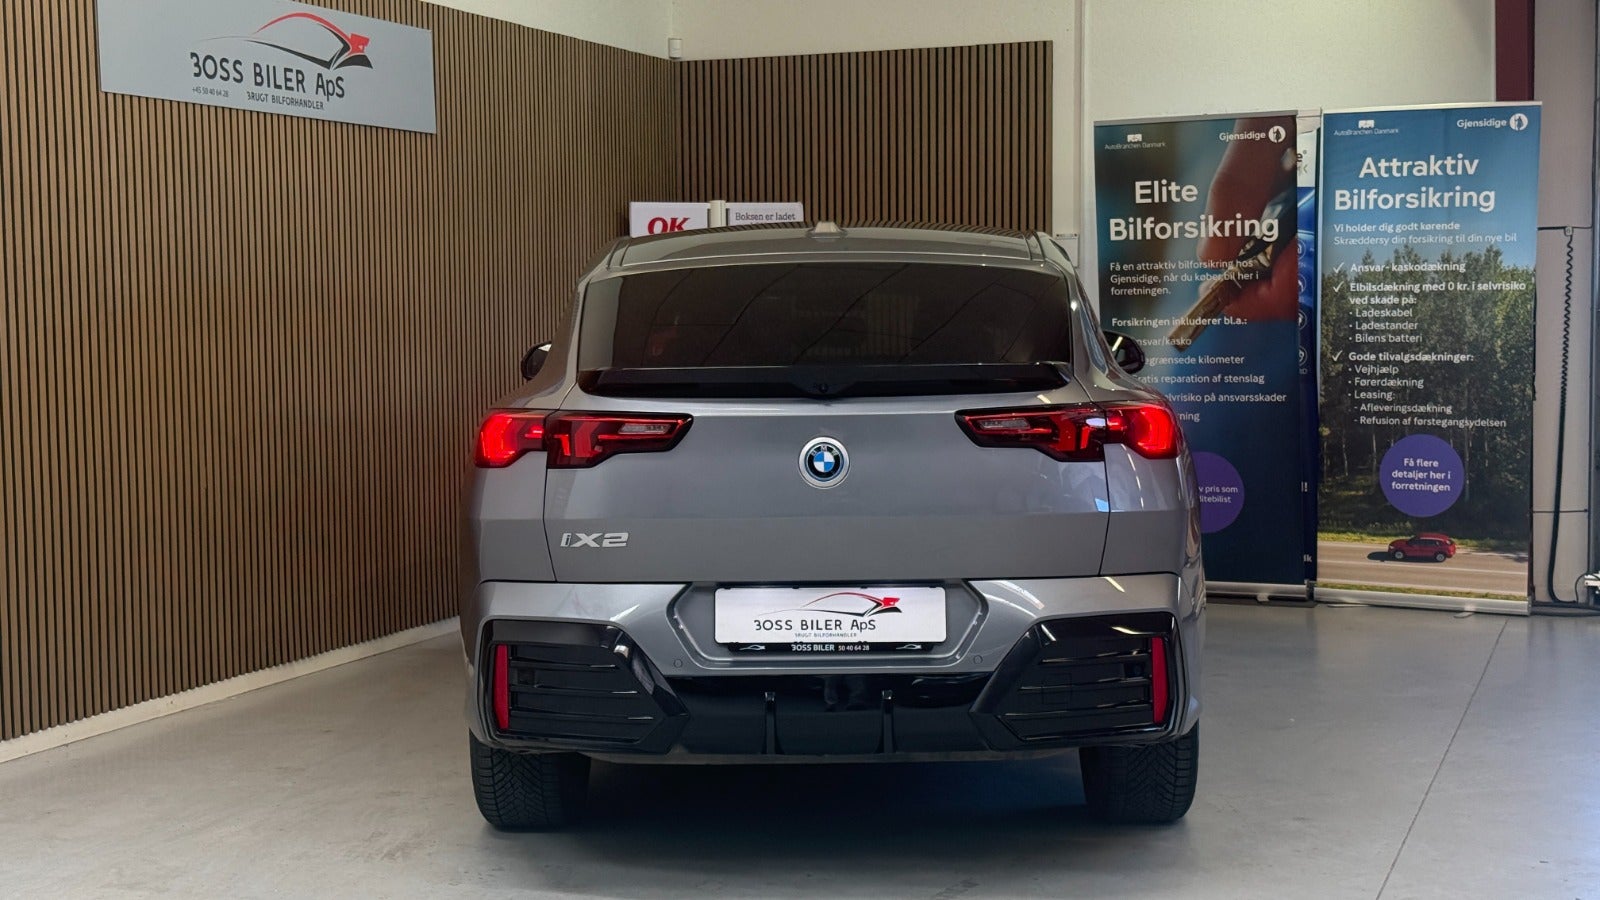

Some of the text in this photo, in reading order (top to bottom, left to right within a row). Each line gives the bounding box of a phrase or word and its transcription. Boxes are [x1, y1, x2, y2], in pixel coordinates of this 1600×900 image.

[253, 62, 306, 93] BILER
[315, 73, 345, 101] ApS
[271, 95, 325, 110] BILFORHANDLER
[1456, 119, 1507, 129] Gjensidige
[1219, 130, 1266, 142] Gjensidige
[1358, 153, 1480, 178] Attraktiv
[1135, 178, 1199, 204] Elite
[1335, 185, 1496, 212] Bilforsikring
[735, 212, 763, 221] Boksen
[775, 212, 796, 221] ladet
[647, 217, 690, 235] OK
[1109, 212, 1279, 243] Bilforsikring
[1334, 221, 1460, 234] Vi holder dig godt kørende
[1334, 233, 1517, 247] Skræddersy din forsikring til din nye bil
[1110, 259, 1253, 271] Få en attraktiv bilforsikring hos
[1350, 262, 1466, 273] Ansvar- kaskodækning
[1110, 273, 1162, 285] Gjensidige,
[1163, 272, 1178, 282] når
[1180, 272, 1193, 281] du
[1194, 272, 1222, 281] køber
[1223, 272, 1236, 281] bil
[1237, 271, 1253, 280] her
[1110, 286, 1171, 297] forretningen.
[1350, 282, 1420, 293] Elbilsdækning
[1422, 282, 1445, 291] med
[1447, 282, 1455, 291] 0
[1457, 281, 1470, 291] kr.
[1477, 281, 1526, 291] selvrisiko
[1350, 295, 1417, 306] ved skade på:
[1355, 308, 1413, 318] Ladeskabel
[1112, 317, 1248, 328] Forsikringen inkluderer bl.a.:
[1355, 321, 1418, 330] Ladestander
[1136, 336, 1192, 346] nsvar/kasko
[1355, 334, 1423, 343] Bilens batteri
[1198, 355, 1245, 365] kilometer
[1348, 352, 1474, 363] Gode tilvalgsdækninger:
[1354, 364, 1399, 375] Vejhjælp
[1161, 374, 1209, 385] reparation
[1211, 374, 1222, 383] af
[1223, 374, 1265, 385] stenslag
[1354, 377, 1424, 389] Førerdækning
[1204, 393, 1216, 403] på
[1217, 393, 1287, 402] ansvarsskader
[1354, 390, 1396, 401] Leasing:
[1359, 403, 1453, 414] Afleveringsdækning
[1359, 416, 1507, 428] Refusion af førstegangsydelsen
[1403, 457, 1439, 468] Få flere
[1391, 469, 1428, 480] detaljer
[1430, 470, 1446, 480] her
[1205, 485, 1220, 494] pris
[1391, 481, 1451, 493] forretningen
[1199, 494, 1232, 504] litebilist
[560, 532, 629, 548] iX2
[800, 619, 843, 631] BILER
[850, 619, 876, 633] ApS
[813, 643, 835, 652] BILER
